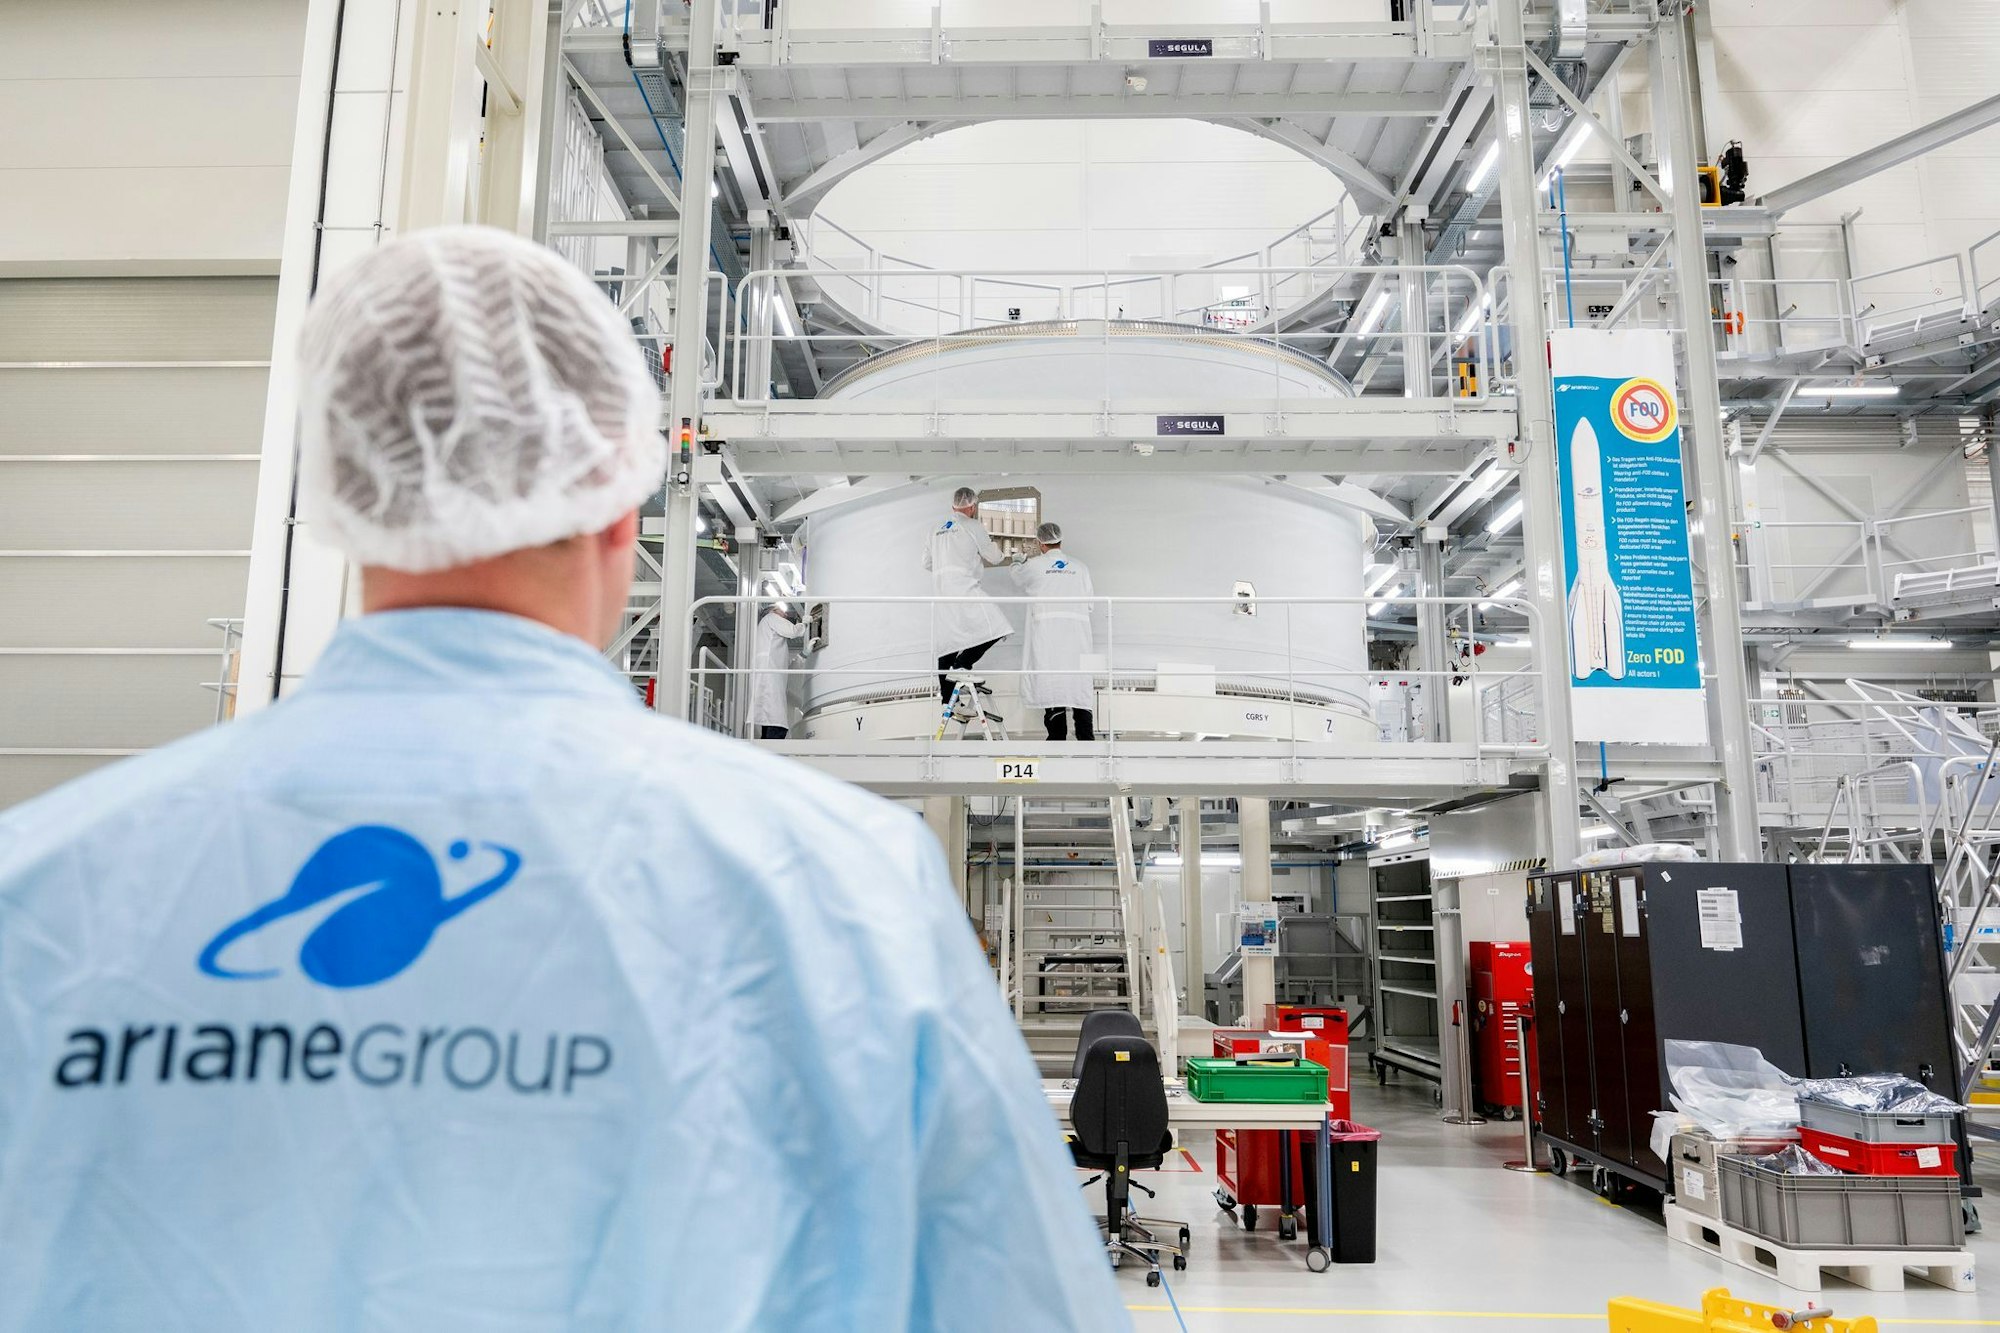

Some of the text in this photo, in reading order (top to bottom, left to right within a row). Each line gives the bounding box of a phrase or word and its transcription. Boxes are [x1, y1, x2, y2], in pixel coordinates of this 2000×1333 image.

[1630, 402, 1659, 417] FOD
[1627, 648, 1685, 664] Zero FOD
[856, 717, 863, 731] Y
[1326, 719, 1332, 733] Z
[1003, 764, 1034, 778] P14
